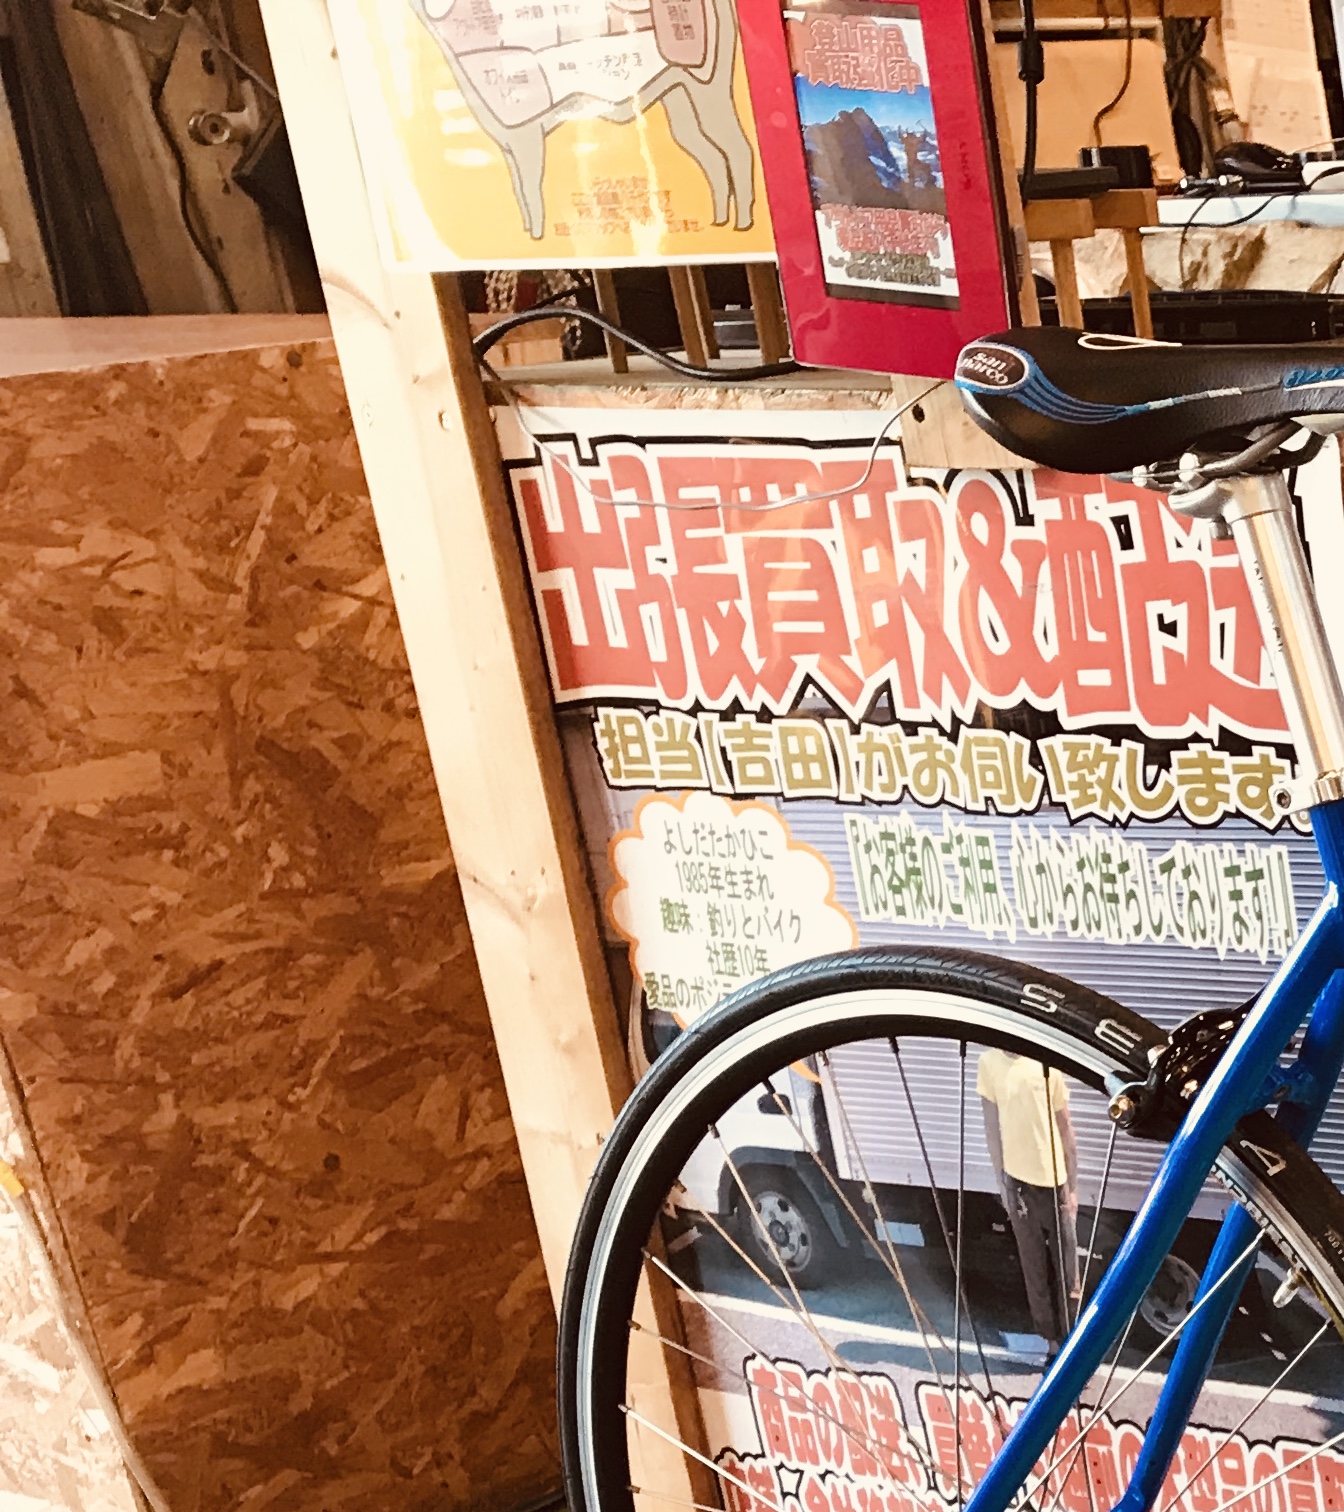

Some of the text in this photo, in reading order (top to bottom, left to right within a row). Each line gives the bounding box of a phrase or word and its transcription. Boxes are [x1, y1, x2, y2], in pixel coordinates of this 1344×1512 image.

[664, 820, 774, 861] よしだたかひこ
[675, 861, 775, 901] 1985年生まれ
[706, 940, 770, 977] 社歴10年
